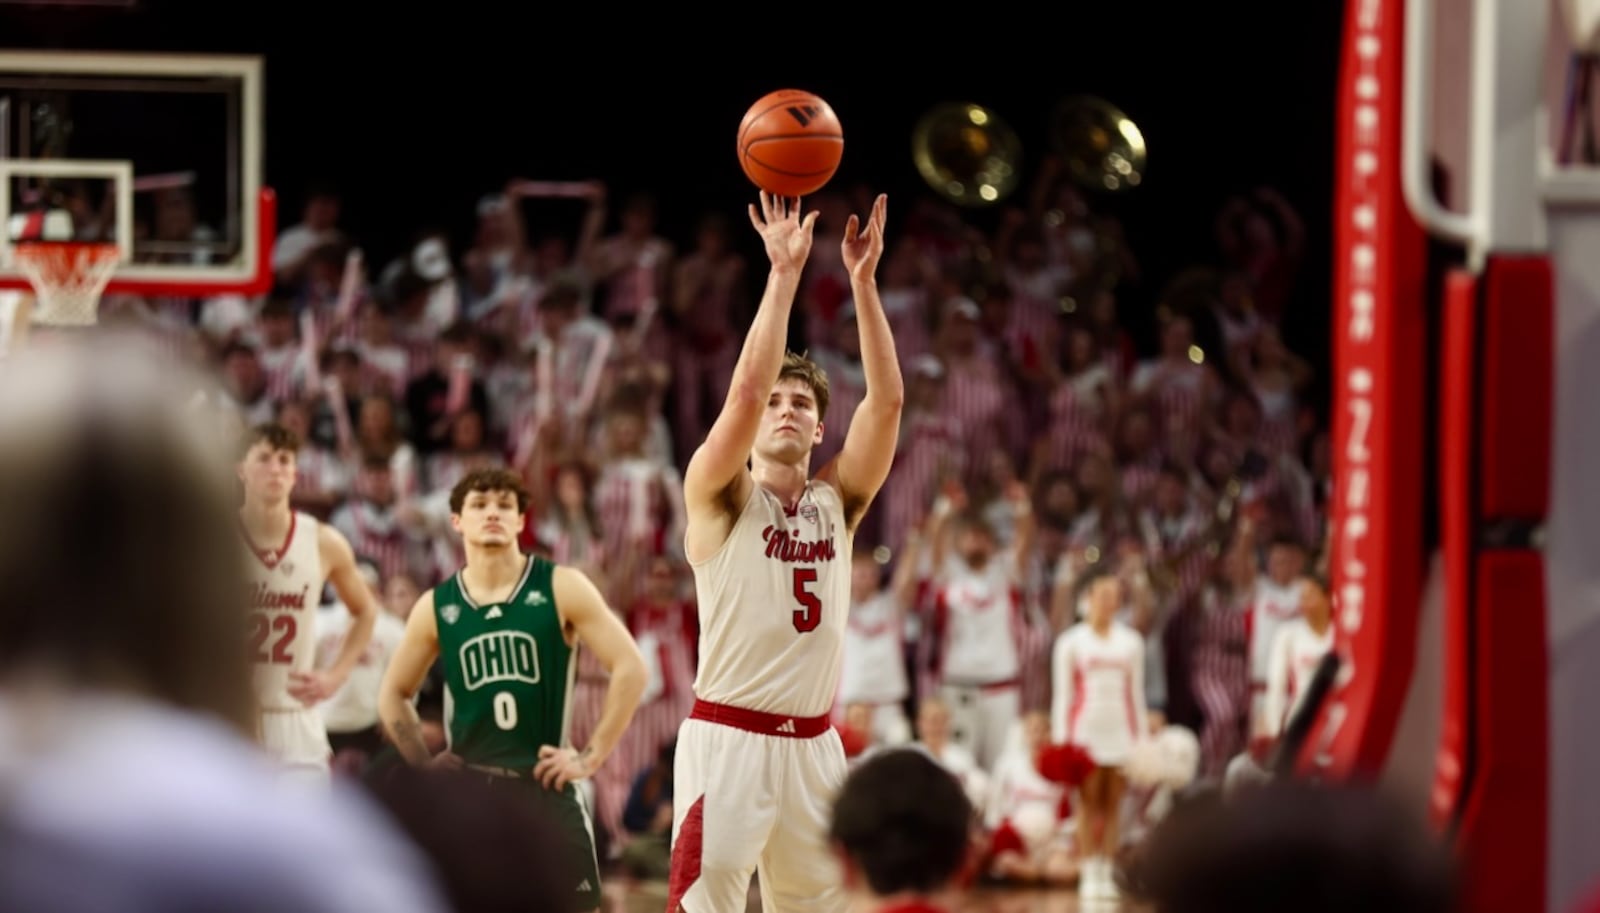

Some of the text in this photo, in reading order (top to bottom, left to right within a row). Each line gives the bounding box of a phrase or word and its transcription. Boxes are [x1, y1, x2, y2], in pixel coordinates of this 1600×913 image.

[762, 523, 836, 563] Miami
[792, 567, 822, 633] 5
[247, 613, 297, 664] 22
[459, 630, 541, 691] OHIO
[493, 691, 518, 730] 0
